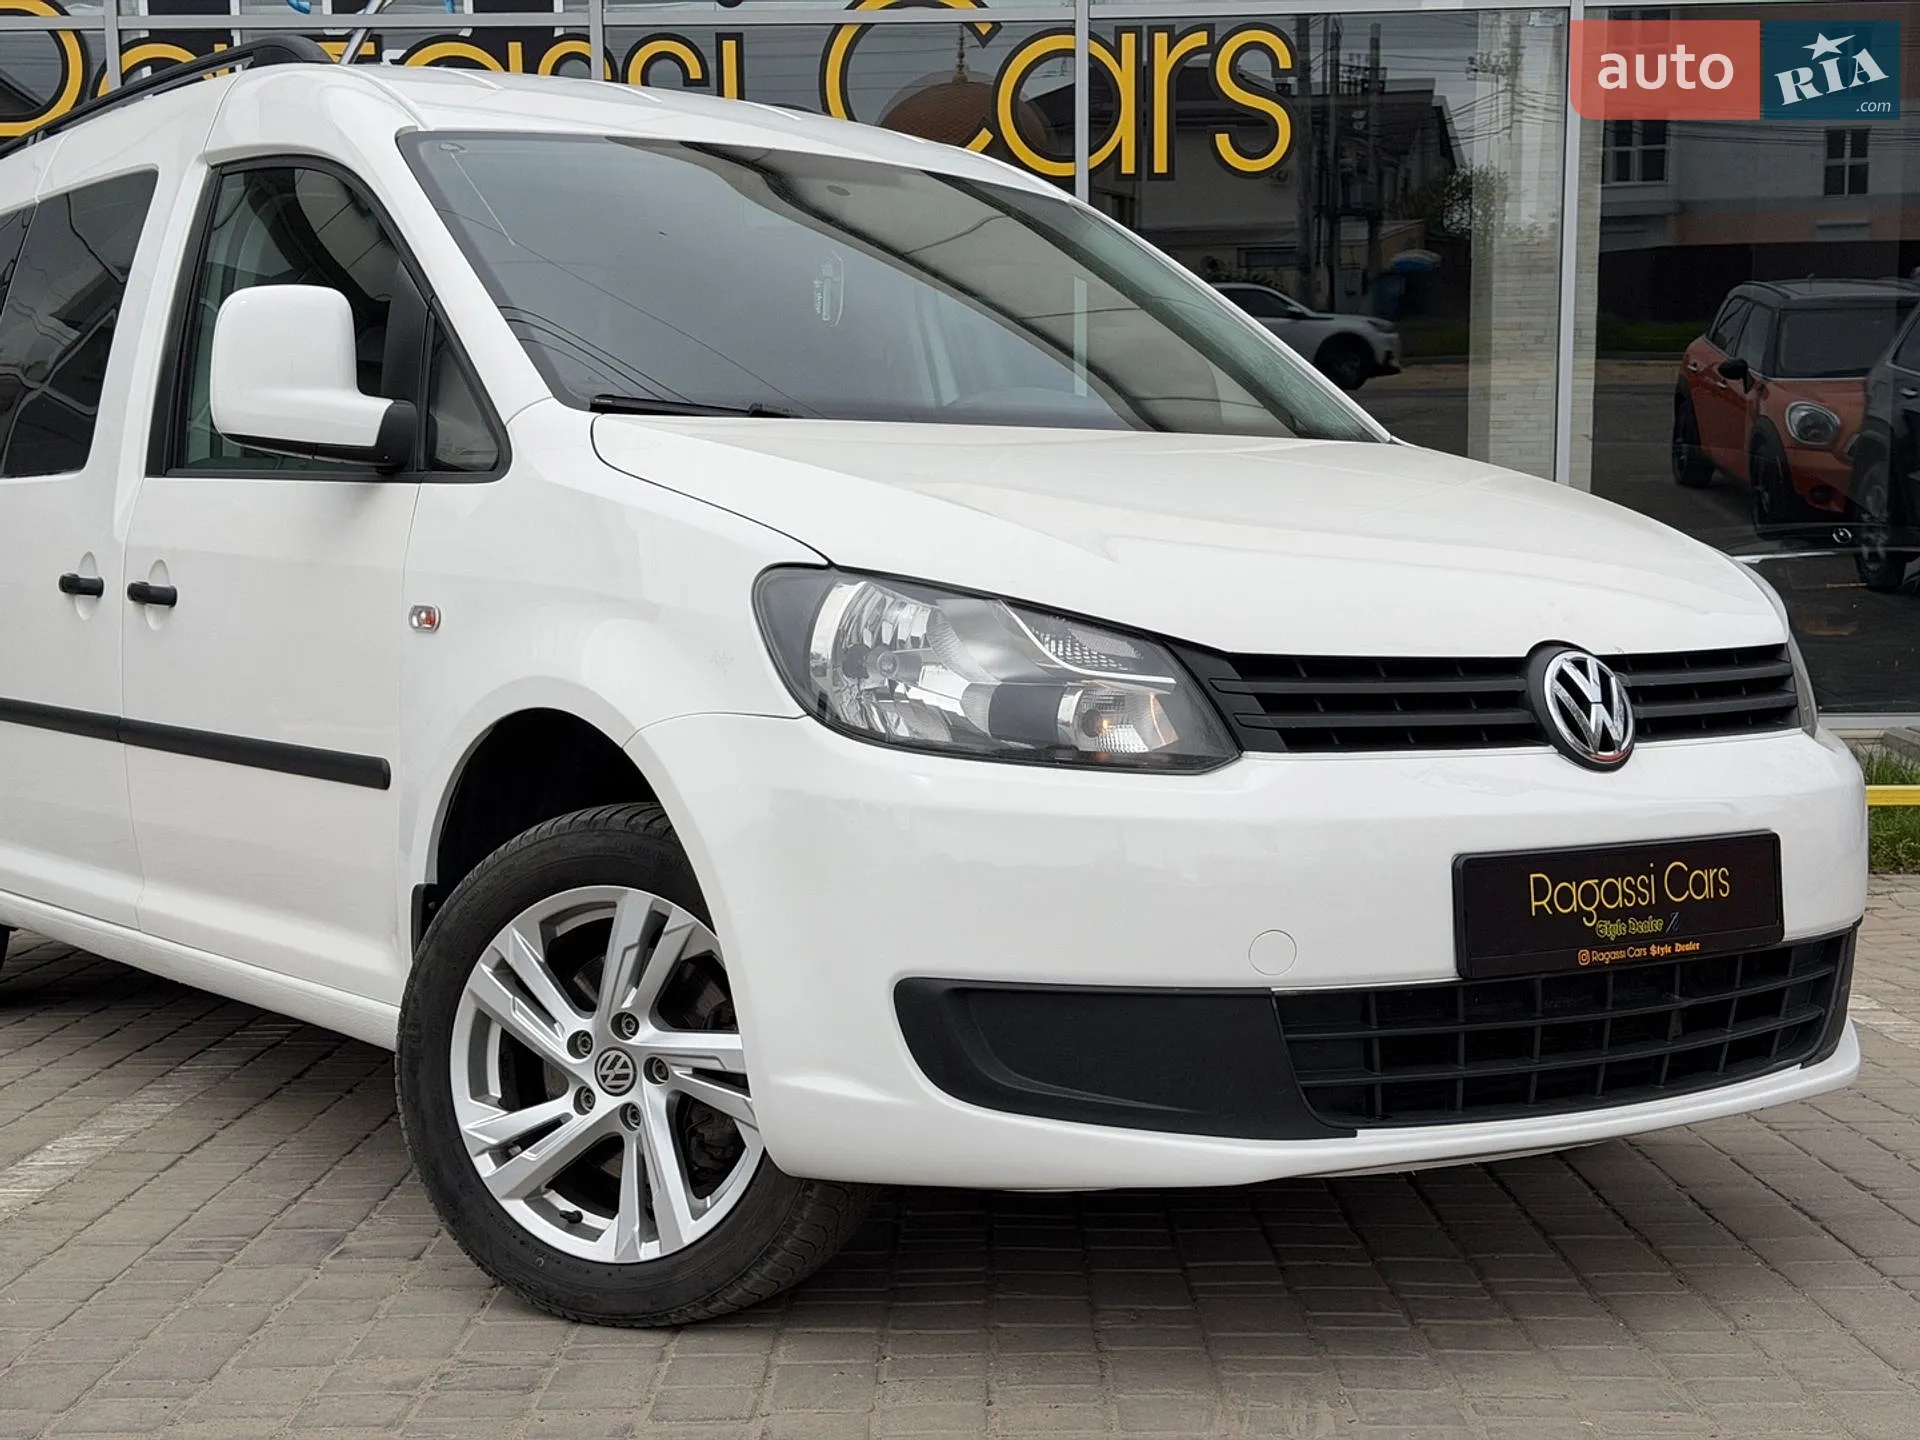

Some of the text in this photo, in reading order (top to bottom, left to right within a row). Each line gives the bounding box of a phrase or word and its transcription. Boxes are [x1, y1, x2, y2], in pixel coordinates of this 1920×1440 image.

[822, 0, 1294, 177] Cars
[1528, 860, 1731, 927] Ragassi Cars
[1590, 947, 1626, 964] Ragassi
[1626, 945, 1648, 958] Cars
